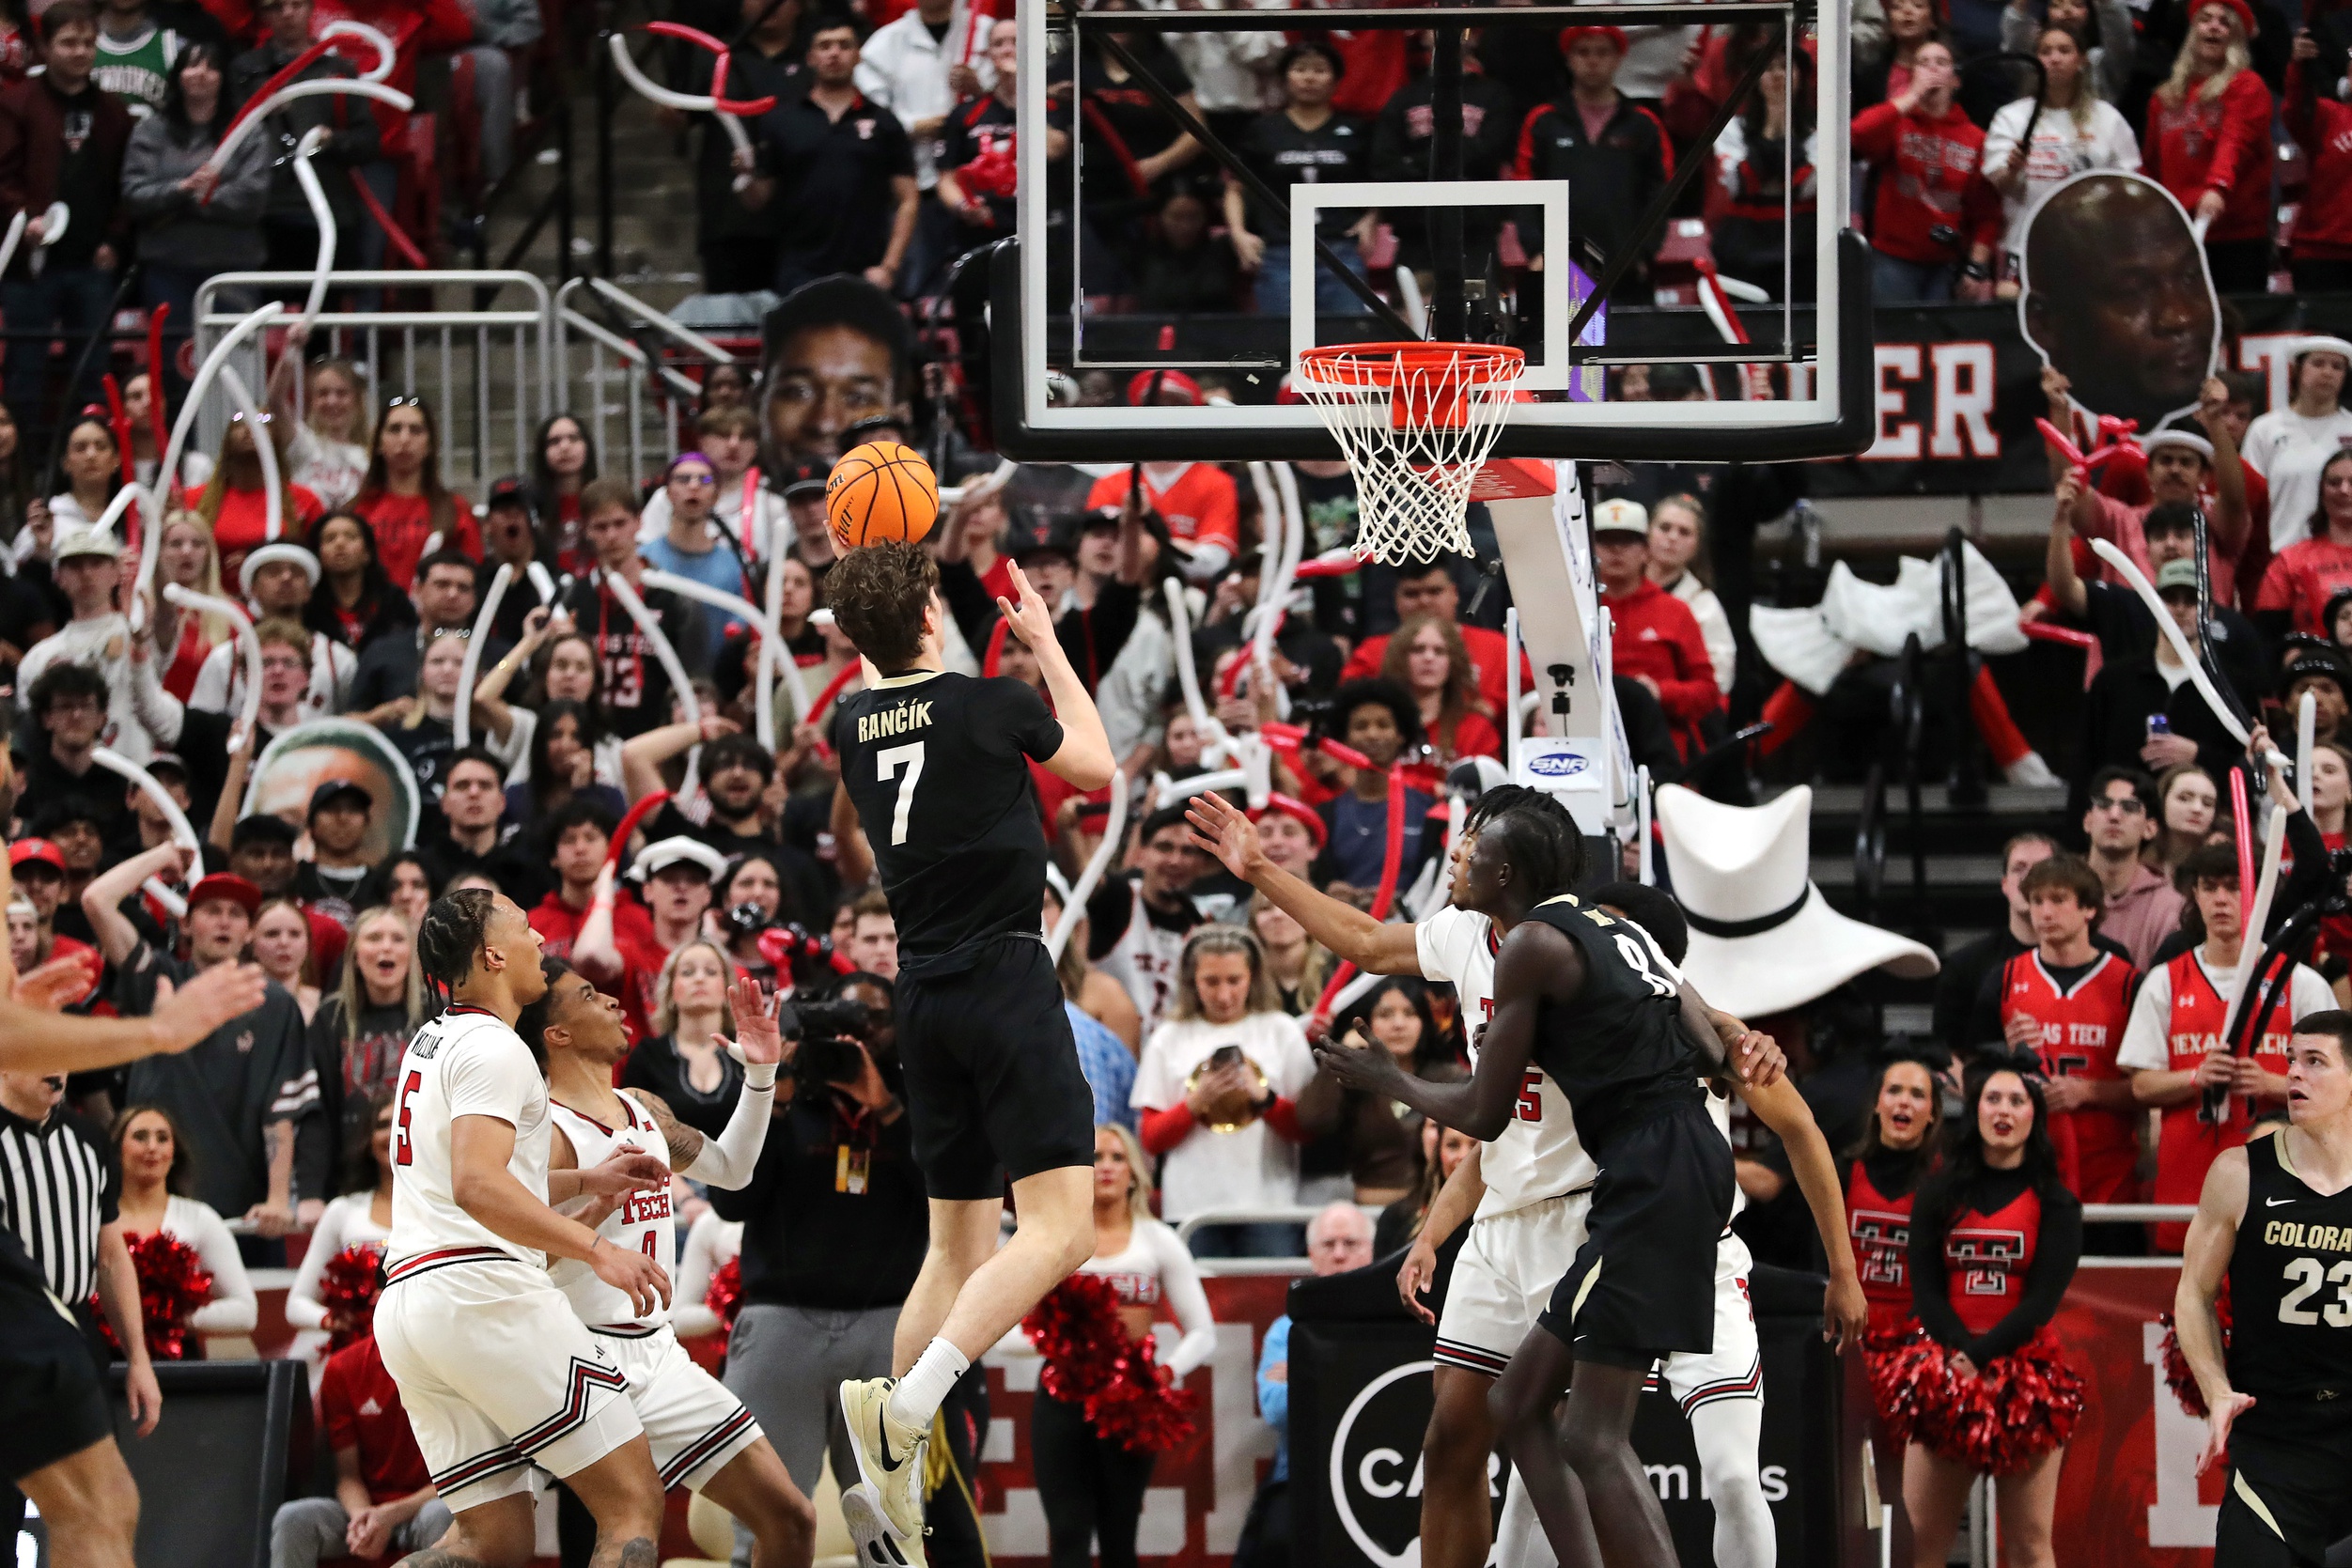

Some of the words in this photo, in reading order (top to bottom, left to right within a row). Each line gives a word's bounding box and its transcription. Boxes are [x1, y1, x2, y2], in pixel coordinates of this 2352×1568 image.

[1858, 340, 2002, 461] ER
[858, 697, 934, 743] RANČÍK
[877, 740, 926, 846] 7
[2069, 1024, 2107, 1048] TECH
[2173, 1032, 2223, 1056] TEXA
[397, 1069, 422, 1167] 5
[1511, 1072, 1544, 1123] 5
[621, 1193, 671, 1226] TECH
[2278, 1257, 2352, 1328] 23
